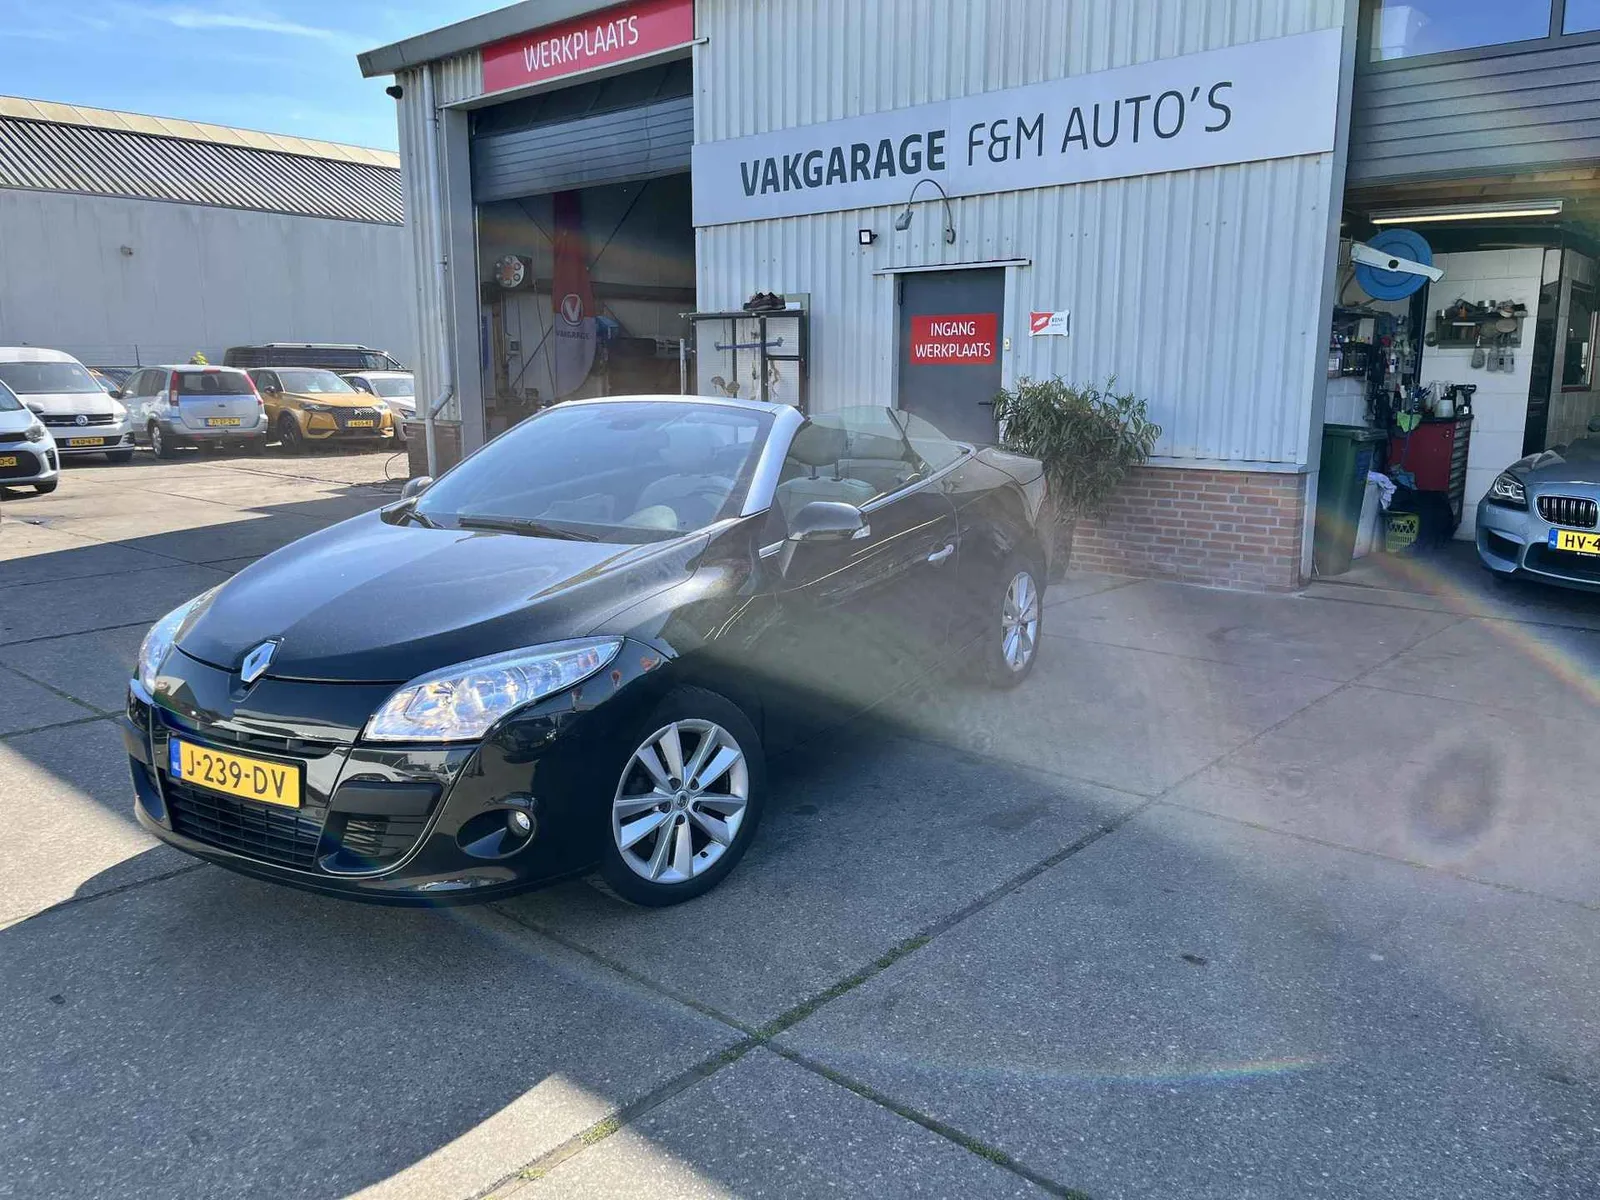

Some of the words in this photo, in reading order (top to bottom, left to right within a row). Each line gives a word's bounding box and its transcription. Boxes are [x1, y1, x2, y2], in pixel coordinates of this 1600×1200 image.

[524, 15, 639, 72] WERKPLAATS
[740, 129, 946, 197] VAKGARAGE
[968, 113, 1045, 166] F&M
[1061, 81, 1233, 153] AUTO'S
[915, 343, 991, 358] WERKPLAATS
[930, 321, 976, 337] INGANG
[187, 750, 286, 799] J-239-DV
